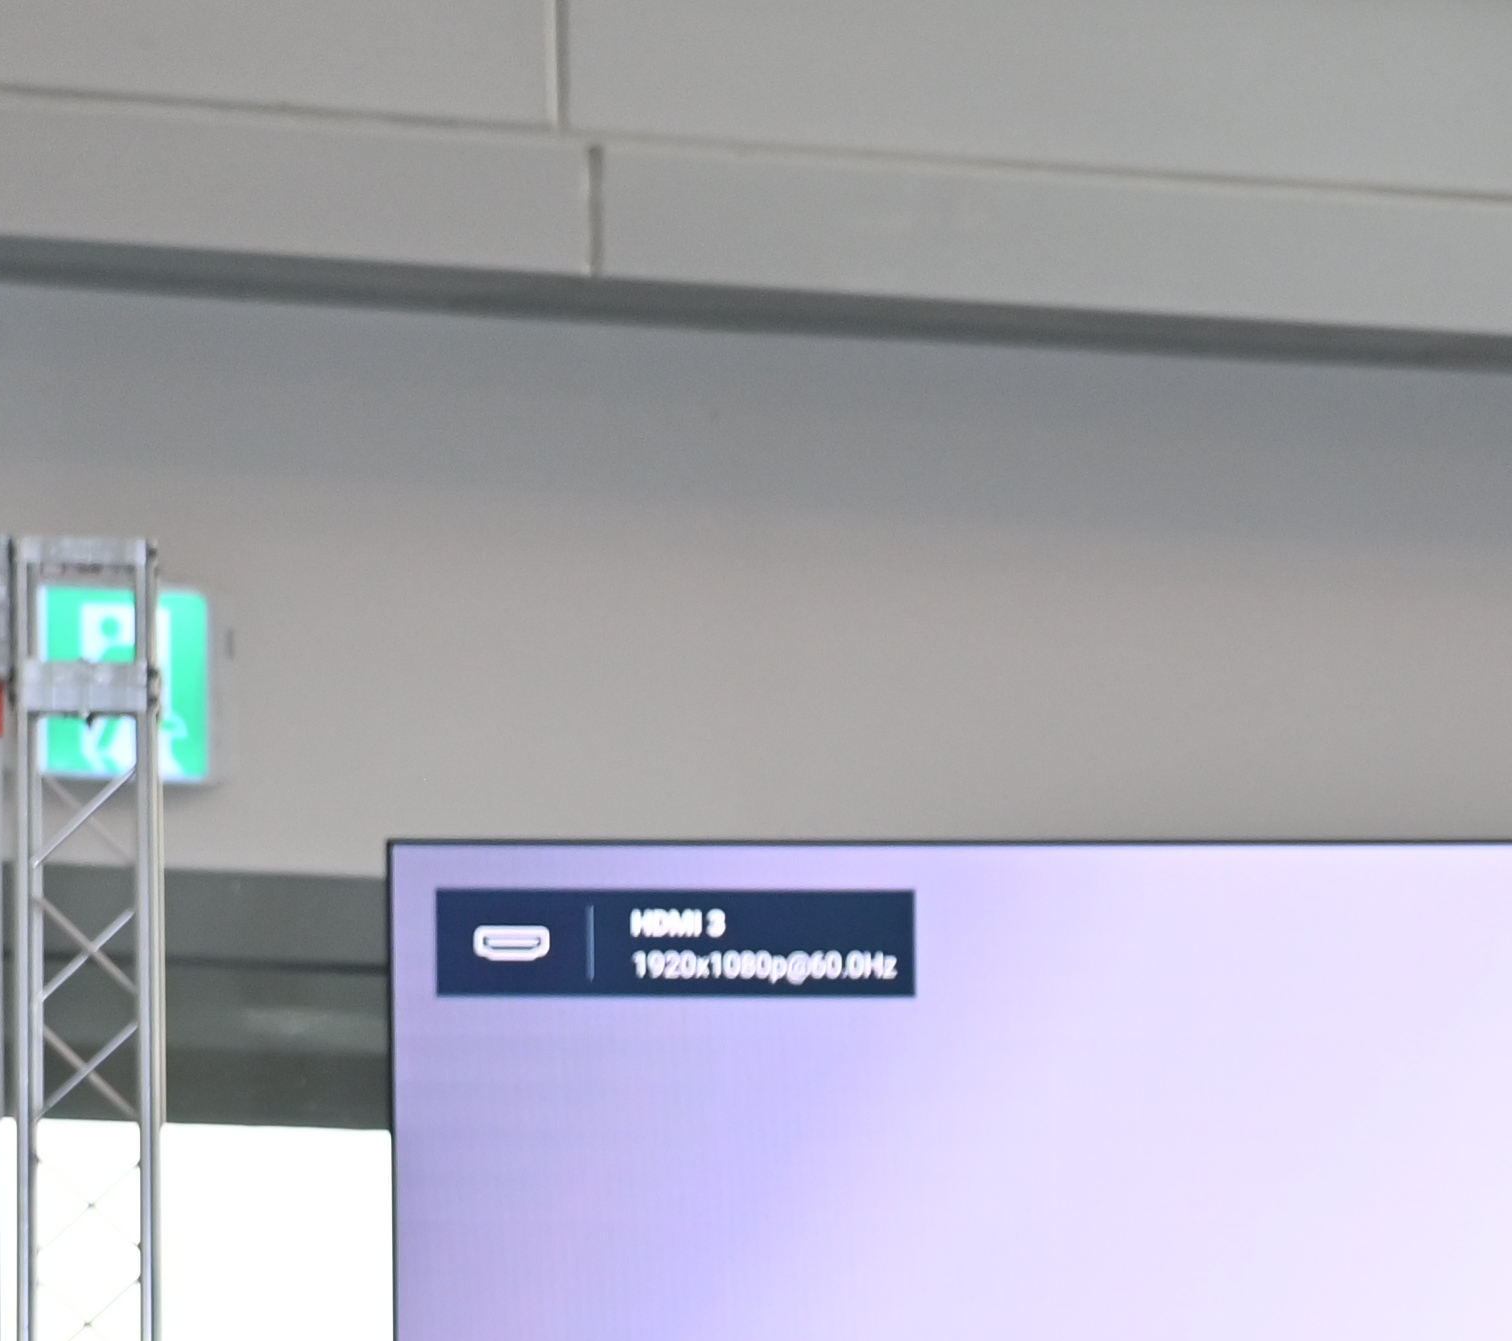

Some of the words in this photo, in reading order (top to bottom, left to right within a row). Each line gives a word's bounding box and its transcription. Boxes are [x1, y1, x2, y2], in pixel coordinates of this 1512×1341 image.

[630, 908, 702, 938] HDMI
[705, 908, 727, 938] 3
[632, 950, 899, 985] 1920x1080p@60.0Hz
